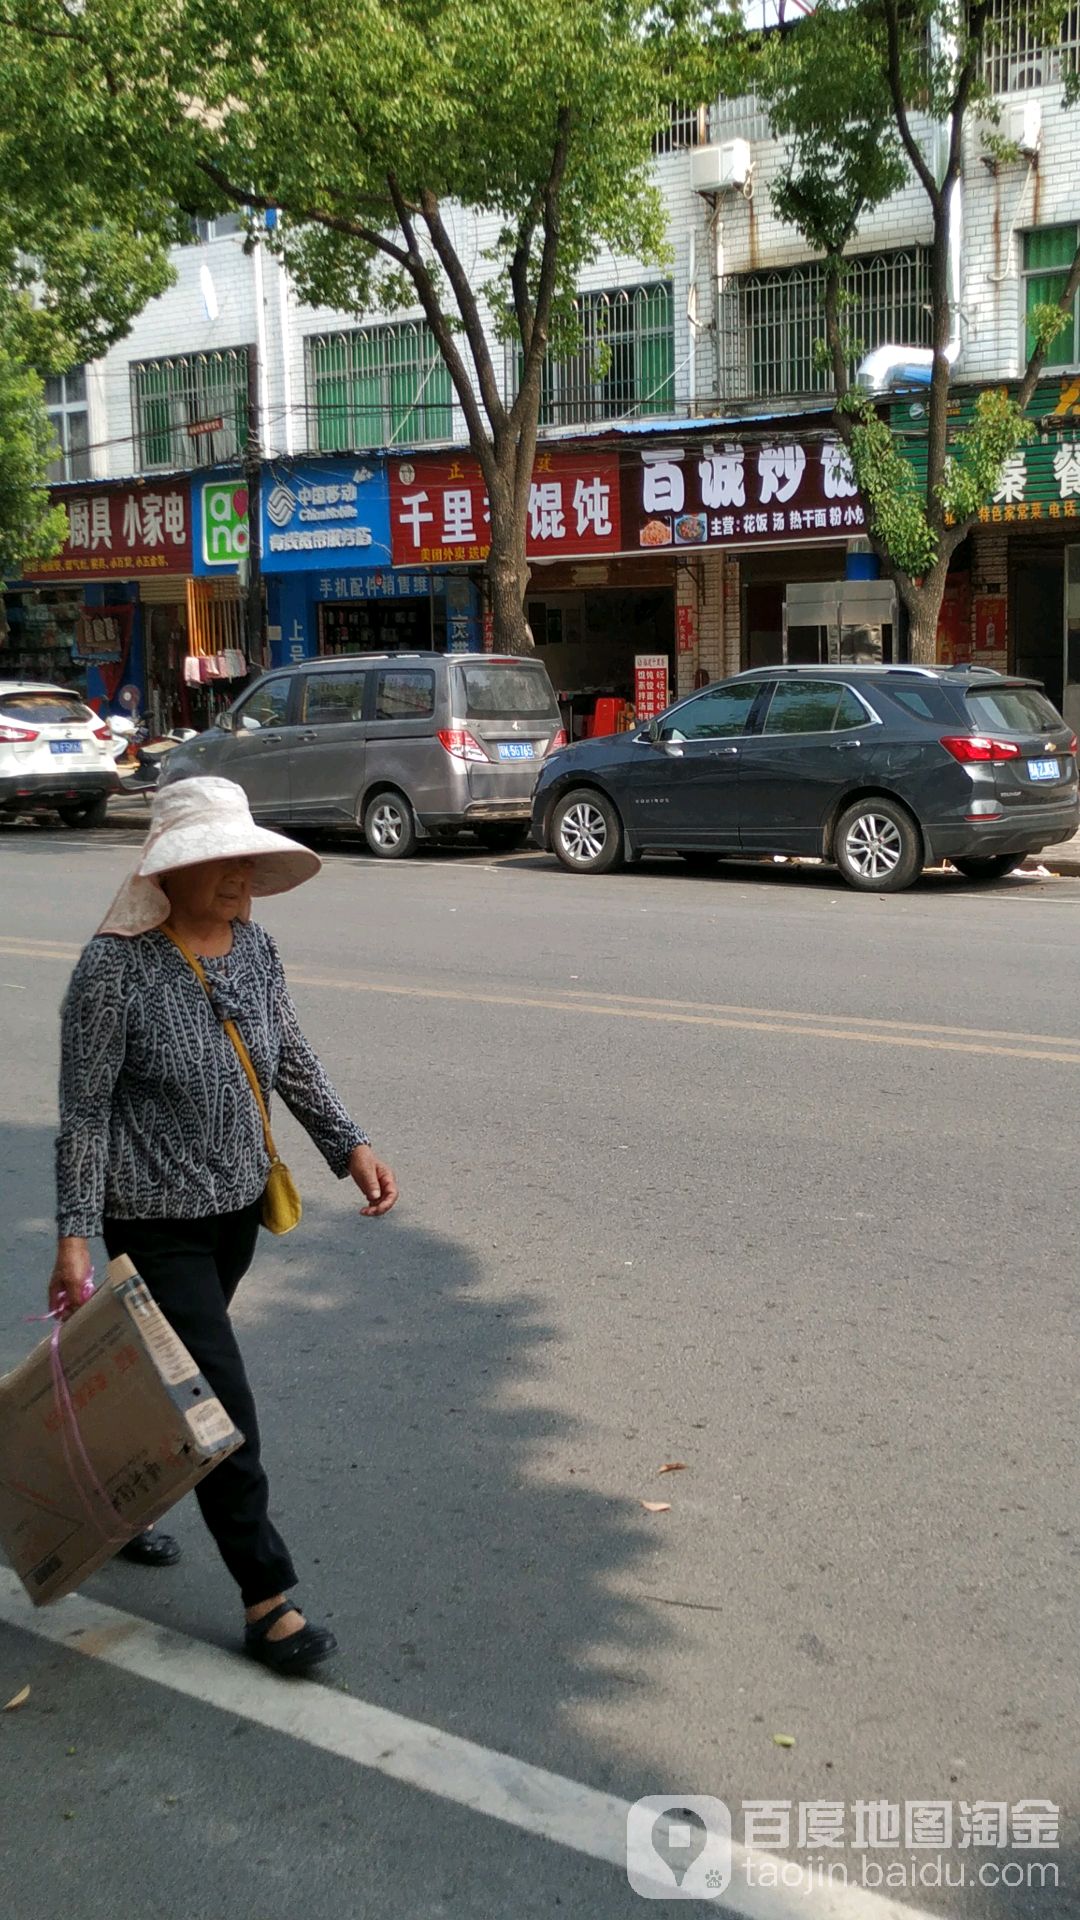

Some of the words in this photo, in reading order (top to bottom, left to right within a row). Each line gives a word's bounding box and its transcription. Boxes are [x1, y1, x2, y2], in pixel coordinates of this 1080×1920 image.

[298, 483, 358, 506] 中国移动
[123, 491, 187, 548] 小家电
[399, 477, 613, 547] 千里馄饨
[772, 511, 785, 532] 汤
[789, 508, 827, 530] 热干面
[829, 506, 842, 527] 粉
[978, 502, 1042, 523] 特色家常菜
[1050, 500, 1076, 519] 电话
[319, 574, 445, 599] 手机配件销售维修
